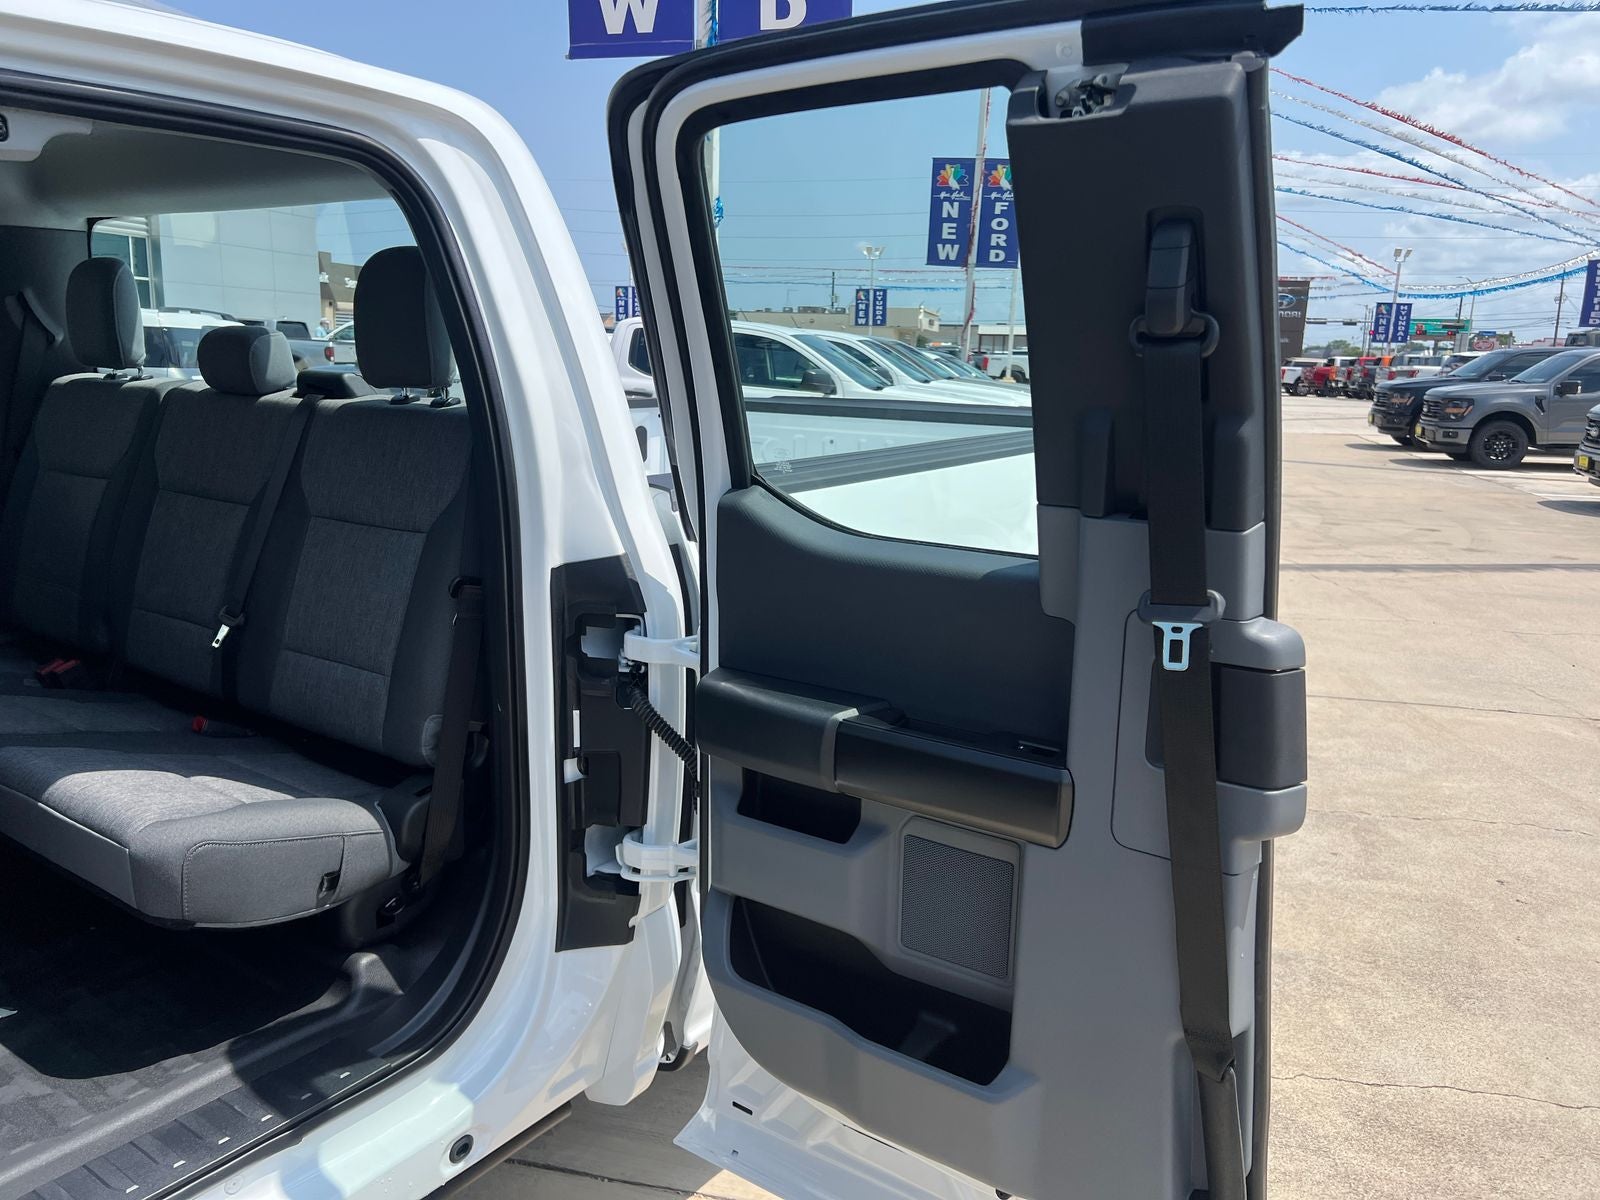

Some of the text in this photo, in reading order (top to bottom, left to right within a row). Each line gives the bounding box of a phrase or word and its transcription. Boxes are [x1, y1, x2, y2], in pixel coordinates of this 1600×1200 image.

[937, 202, 960, 261] NEW
[988, 202, 1010, 262] FORD
[857, 303, 867, 325] NEW
[875, 291, 883, 325] HYUNDAI
[1396, 305, 1408, 341] HYUNDAI
[1375, 318, 1387, 341] NEW
